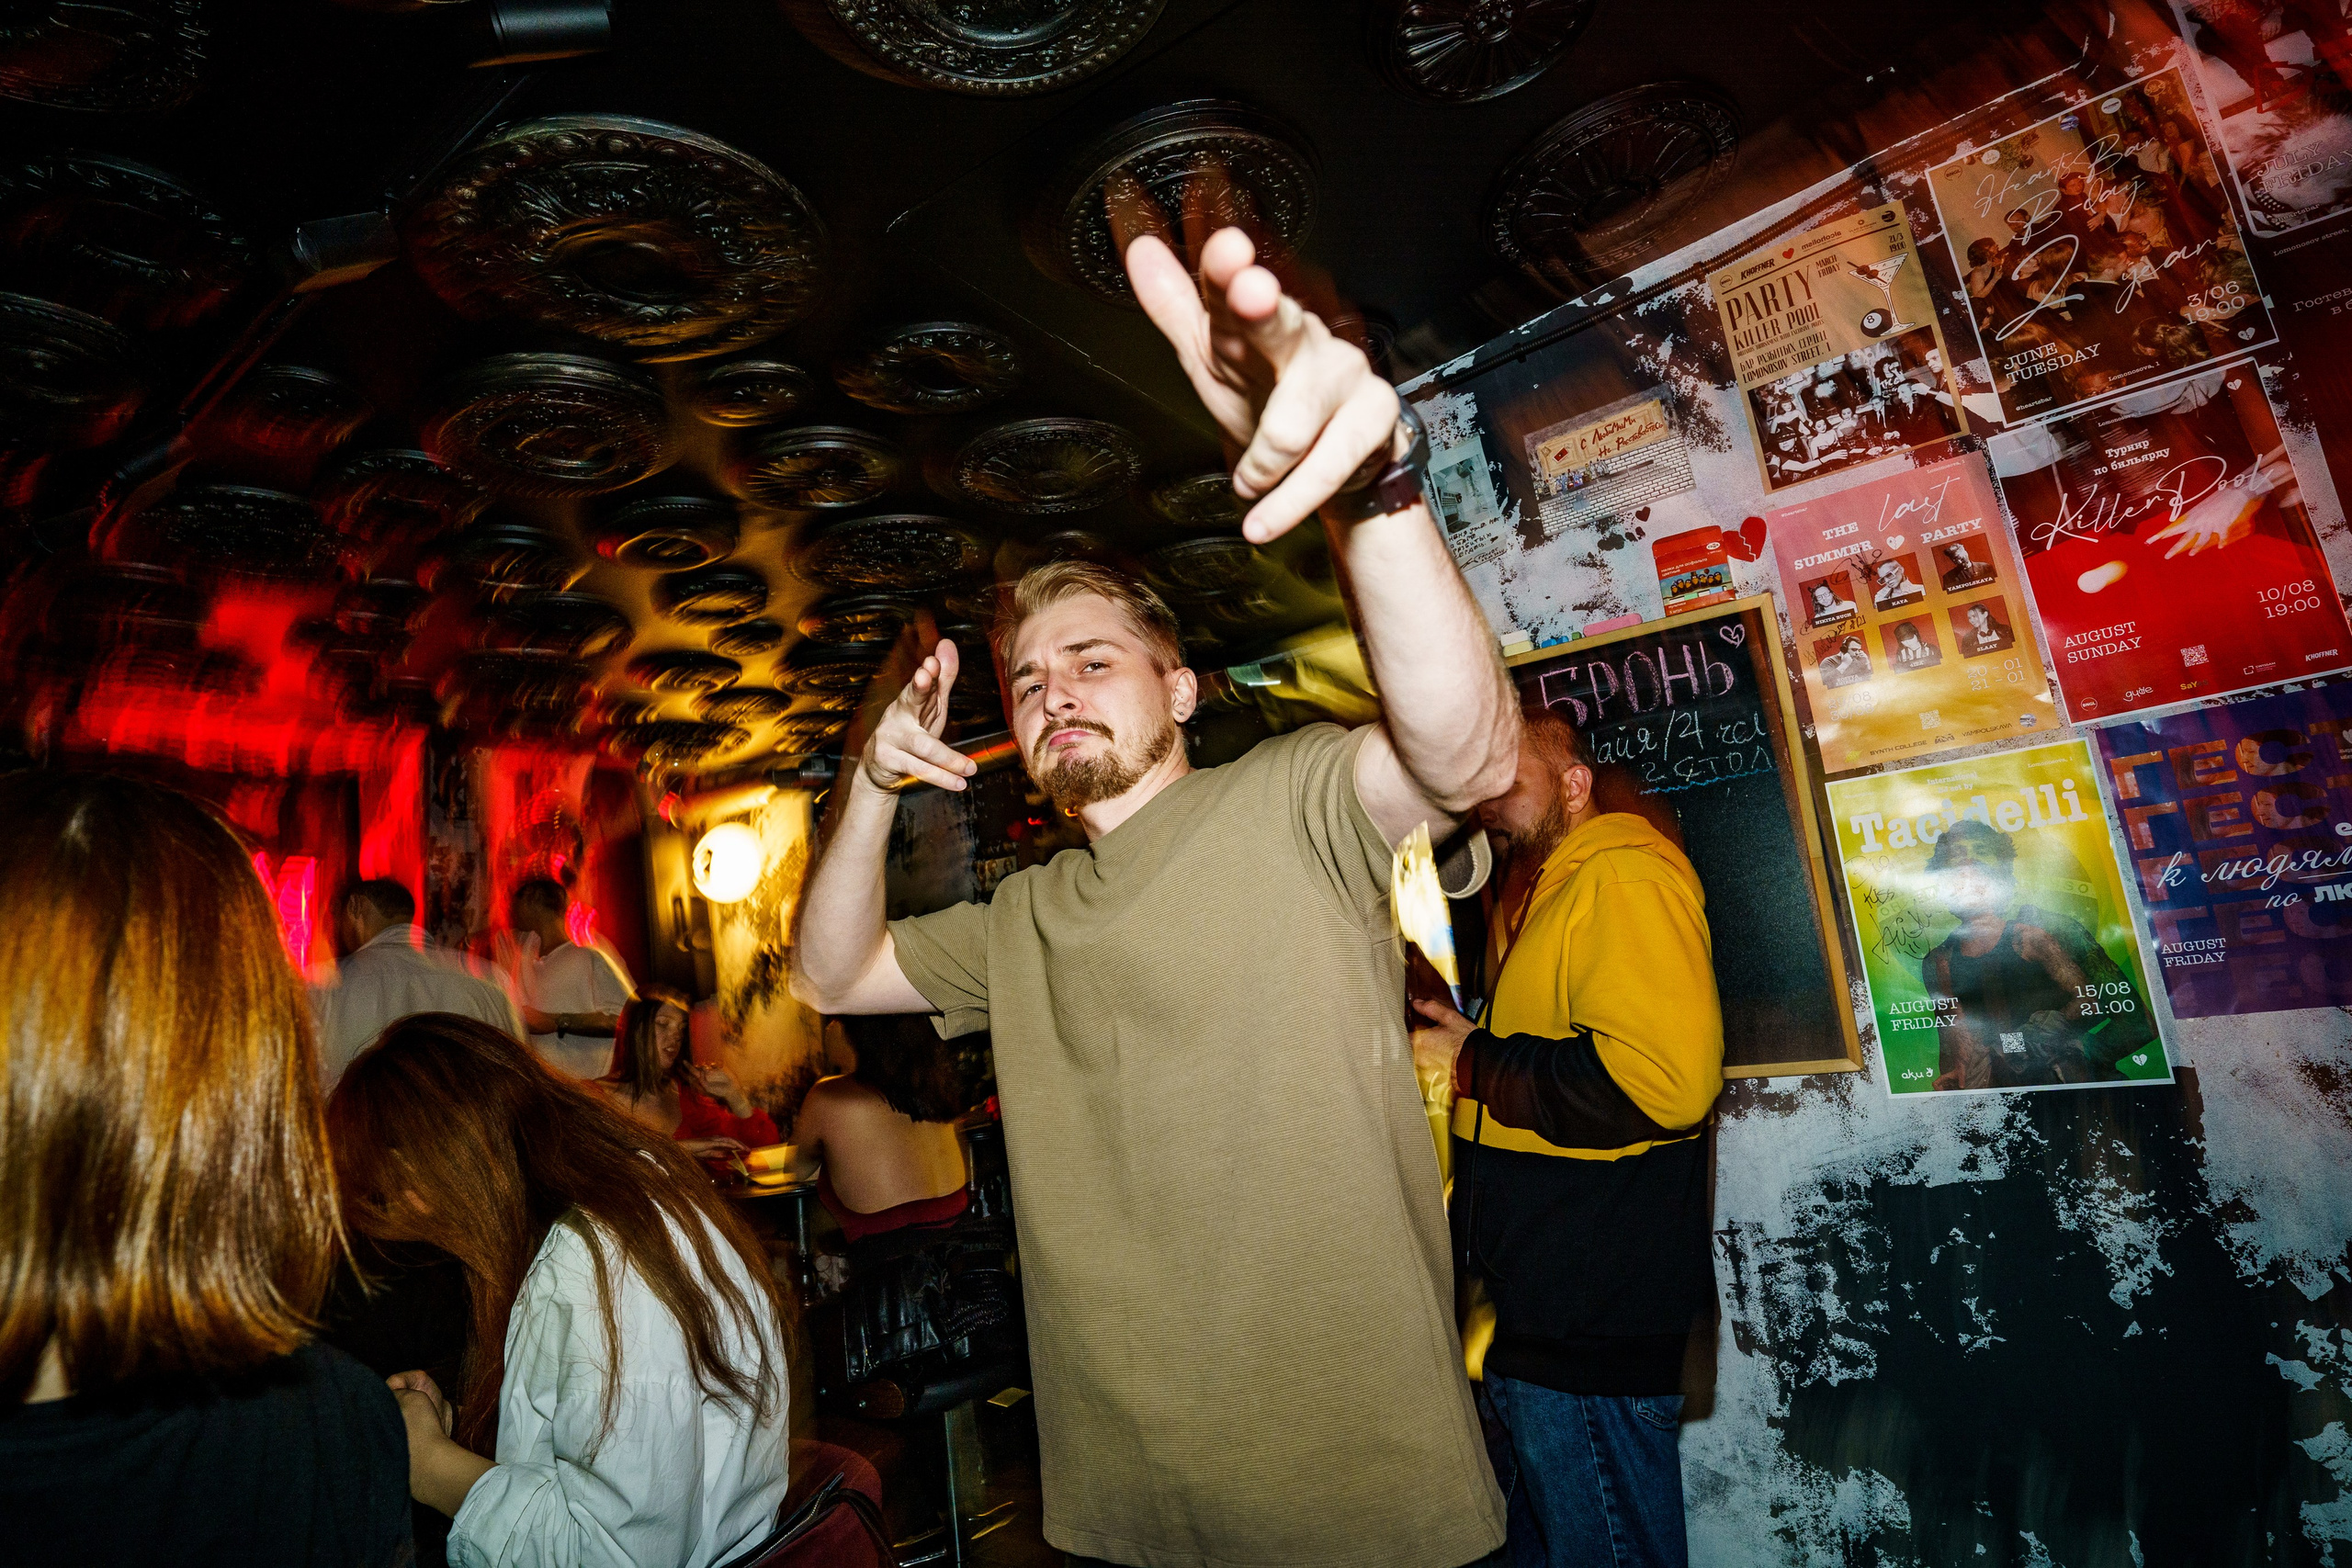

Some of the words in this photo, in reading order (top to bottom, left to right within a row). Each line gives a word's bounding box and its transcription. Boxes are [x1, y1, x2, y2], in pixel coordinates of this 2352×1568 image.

[2256, 140, 2324, 177] JULY
[2273, 236, 2320, 256] Lomonosov
[1740, 258, 1776, 280] KHOFFNER
[1815, 254, 1838, 268] MARCH
[1817, 263, 1841, 278] FRIDAY
[1724, 265, 1814, 332] PARTY
[1995, 233, 2086, 342] 2
[2115, 239, 2217, 314] year
[2187, 280, 2240, 308] 3/06
[1866, 315, 1875, 323] 8
[2185, 295, 2246, 326] 19:00
[1733, 318, 1781, 351] KILLER
[1786, 302, 1824, 331] POOL
[1740, 358, 1755, 372] БАР
[1757, 342, 1797, 366] РАЗБИТЫХ
[1798, 330, 1827, 349] СЕРДЕЦ
[2003, 343, 2059, 370] JUNE
[2006, 343, 2102, 385] TUESDAY
[1742, 358, 1789, 384] LOMONOSOV
[2093, 465, 2109, 476] по
[2110, 446, 2170, 470] бильярду
[2105, 439, 2150, 457] Турнир
[1878, 476, 1961, 532] last
[2030, 483, 2164, 551] Killer
[1793, 540, 1873, 570] SUMMER
[1920, 517, 1983, 544] PARTY
[1822, 522, 1859, 540] THE
[2256, 580, 2316, 603] 10/08
[2264, 596, 2321, 618] 19:00
[2064, 621, 2137, 649] AUGUST
[2067, 636, 2143, 663] SUNDAY
[2305, 649, 2338, 661] KHOFFNER
[1539, 640, 1735, 728] БРОНЬ
[1894, 739, 1928, 751] COLLEGE
[1849, 778, 2088, 854] Tacidelli
[2161, 938, 2226, 954] AUGUST
[2164, 952, 2226, 967] FRIDAY
[2075, 981, 2132, 998] 15/08
[1888, 997, 1959, 1016] AUGUST
[2079, 998, 2136, 1017] 21:00
[1891, 1014, 1958, 1032] FRIDAY
